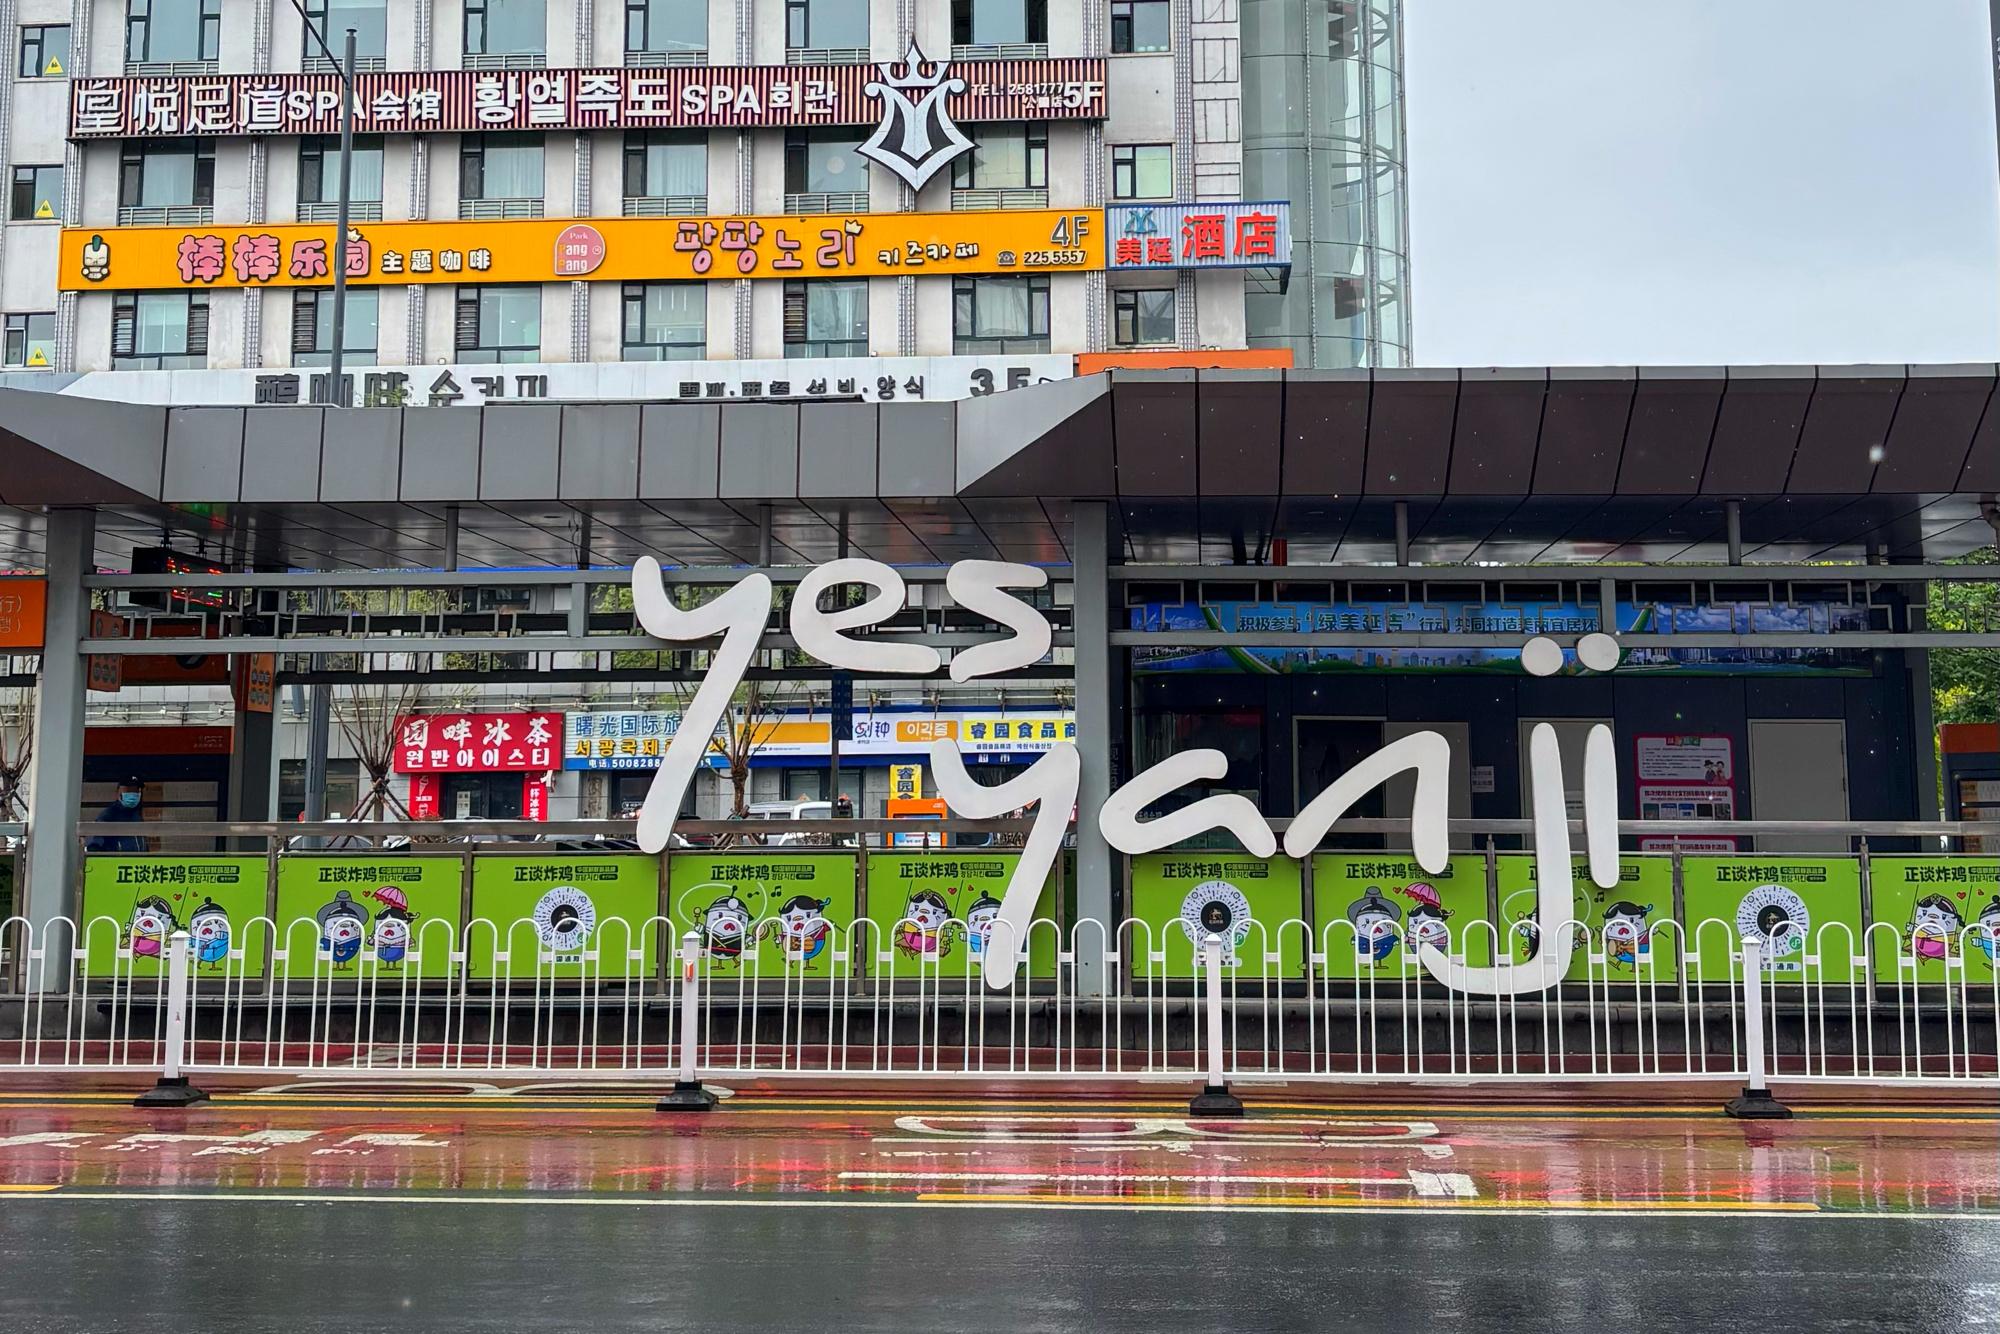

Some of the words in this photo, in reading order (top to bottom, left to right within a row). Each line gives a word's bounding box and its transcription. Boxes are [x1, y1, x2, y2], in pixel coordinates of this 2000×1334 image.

[474, 75, 673, 124] 황열족도
[682, 84, 762, 116] SPA
[769, 80, 838, 116] 회관
[971, 84, 1004, 96] TEL:
[1008, 82, 1064, 95] 2581777
[1063, 81, 1104, 109] 5F
[569, 231, 589, 240] Park
[1050, 213, 1090, 248] 4F
[1181, 211, 1277, 258] 酒店
[177, 232, 371, 283] 棒棒乐园
[381, 248, 492, 274] 主题咖啡
[877, 240, 980, 266] 키즈카페
[969, 367, 1032, 397] 3F
[632, 556, 1052, 855] yes
[403, 716, 553, 750] 园畔冰茶
[406, 747, 550, 769] 원반아이스티
[930, 632, 1620, 994] yanji
[116, 864, 187, 884] 正谈炸鸡
[318, 866, 377, 882] 正谈炸鸡
[513, 865, 573, 882] 正谈炸鸡
[711, 864, 770, 881] 正谈炸鸡
[899, 862, 959, 878] 正谈炸鸡
[1162, 862, 1222, 879] 正谈炸鸡
[1345, 862, 1407, 879] 正谈炸鸡
[1716, 865, 1779, 882] 正谈炸鸡
[1904, 866, 1967, 883] 正谈炸鸡
